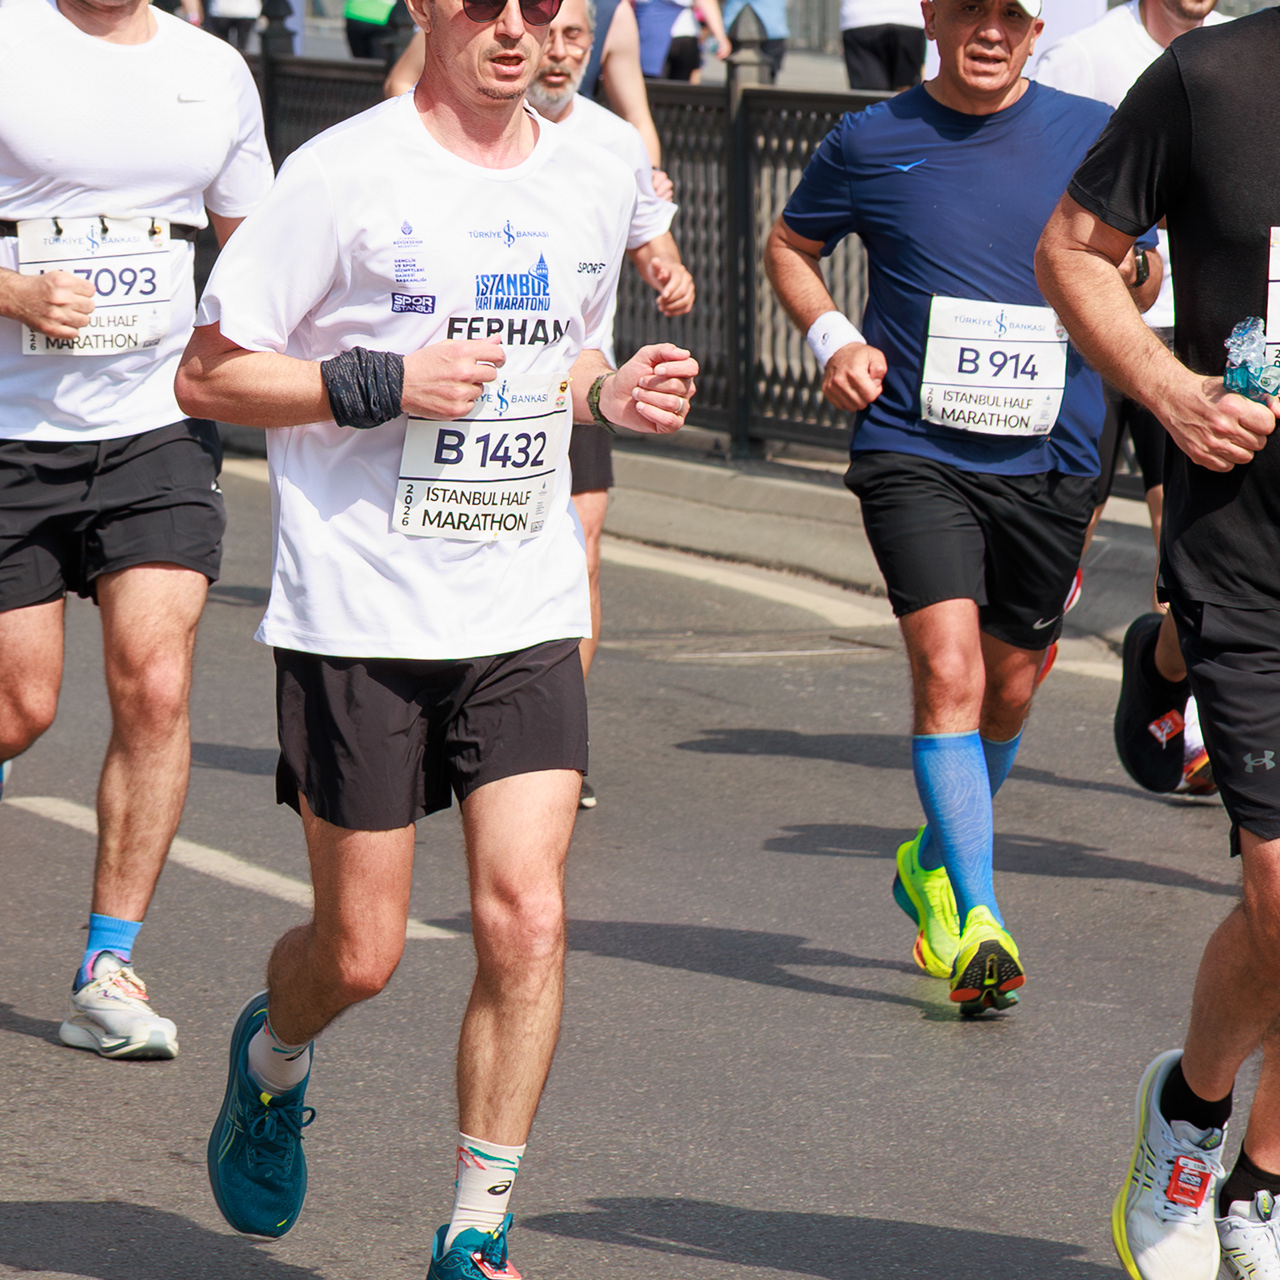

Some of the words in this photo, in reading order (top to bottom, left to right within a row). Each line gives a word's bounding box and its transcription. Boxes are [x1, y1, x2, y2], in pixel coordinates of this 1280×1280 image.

[469, 230, 502, 238] TÜRKİYE
[475, 273, 550, 298] İSTANBUL
[394, 295, 433, 307] SPOR
[475, 296, 492, 311] YARI
[494, 296, 551, 311] MARATONU
[108, 315, 138, 327] HALF
[954, 315, 992, 327] TÜRKİYE
[1009, 322, 1046, 332] BANKASI
[46, 333, 138, 350] MARATHON
[957, 346, 980, 375] B
[989, 350, 1039, 381] 914
[511, 393, 549, 403] BANKASI
[943, 390, 1002, 407] ISTANBUL
[1004, 397, 1033, 410] HALF
[940, 407, 1031, 429] MARATHON
[433, 428, 466, 465] B
[475, 431, 547, 469] 1432
[426, 486, 498, 506] ISTANBUL
[500, 490, 532, 506] HALF
[421, 509, 529, 531] MARATHON
